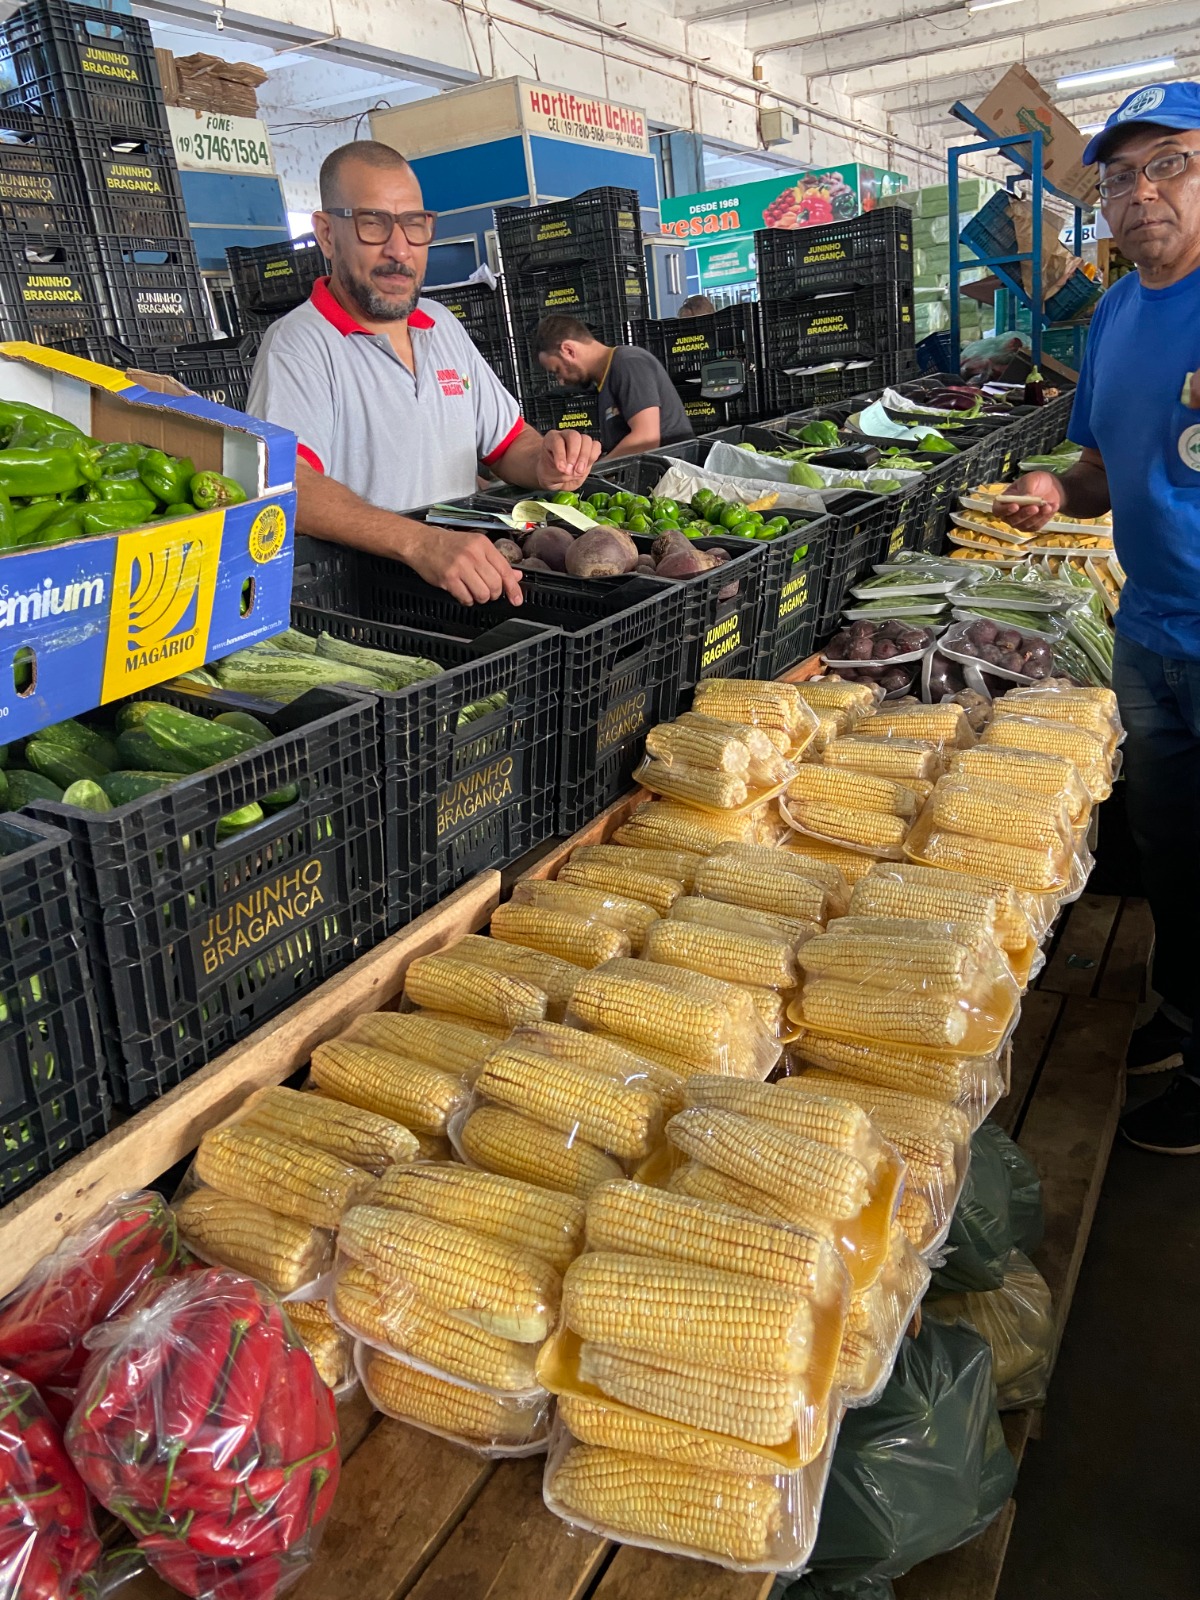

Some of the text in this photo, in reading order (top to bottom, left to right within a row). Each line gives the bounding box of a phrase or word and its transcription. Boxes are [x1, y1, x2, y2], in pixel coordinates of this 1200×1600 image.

[86, 47, 129, 66] JUNINHO
[82, 60, 138, 82] BRAGANÇA
[530, 90, 644, 136] Hortifruti Uchida
[206, 115, 234, 131] FONE:
[110, 164, 152, 179] JUNINHO
[0, 173, 51, 189] JUNINHO
[107, 177, 161, 194] BRAGANÇA
[0, 186, 55, 203] BRAGANÇA
[689, 198, 739, 214] DESDE 1968
[540, 220, 567, 232] JUNINHO
[537, 227, 572, 241] BRAGANÇA
[808, 242, 841, 254] JUNINHO
[803, 250, 846, 264] BRAGANÇA
[26, 275, 72, 288] JUNINHO
[23, 289, 82, 303] BRAGANÇA
[136, 292, 182, 304] JUNINHO
[545, 293, 580, 307] BRAGANÇA
[548, 287, 576, 299] JUNINHO
[137, 303, 185, 316] BRAGANÇA
[811, 315, 844, 326] JUNINHO
[807, 323, 848, 335] BRAGANÇA
[675, 334, 705, 345] JUNINHO
[671, 342, 710, 353] BRAGANÇA
[558, 418, 592, 429] BRAGANÇA
[562, 411, 588, 422] JUNINHO
[778, 589, 808, 618] RAGANÇA
[704, 614, 739, 647] JUNINHO
[125, 634, 195, 673] MAGÁRIO
[598, 692, 646, 732] UNINHO
[597, 711, 644, 752] RAGANÇA
[437, 756, 514, 814] JUNINHO
[436, 776, 513, 836] BRAGANÇA
[201, 859, 323, 948] JUNINHO
[202, 885, 324, 975] BRAGANÇA
